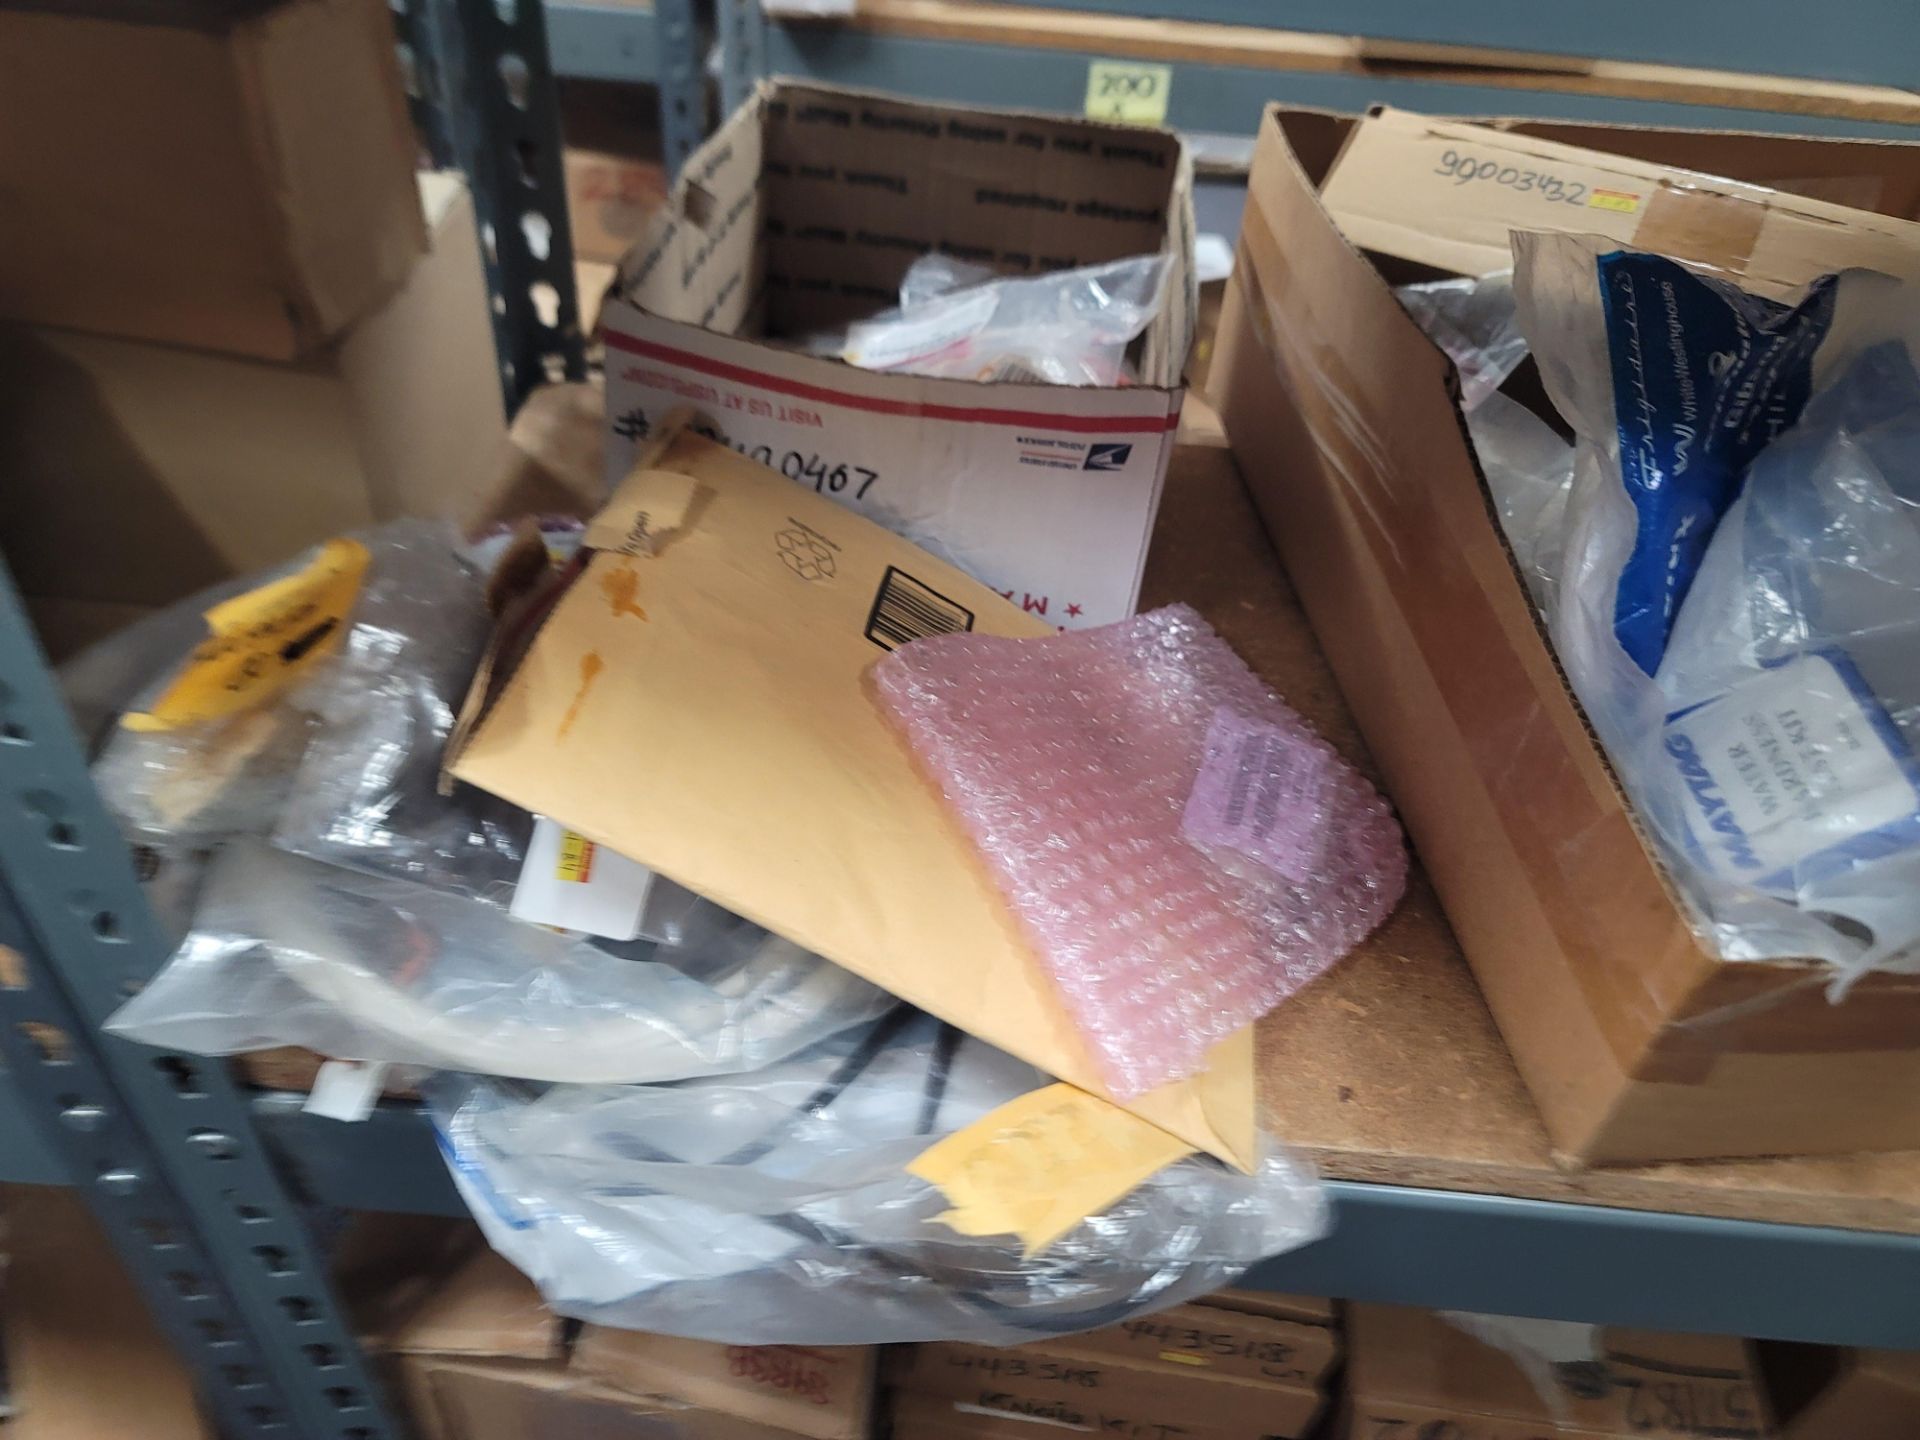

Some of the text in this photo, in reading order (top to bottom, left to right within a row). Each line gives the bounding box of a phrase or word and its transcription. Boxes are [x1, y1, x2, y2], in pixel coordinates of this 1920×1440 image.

[747, 397, 774, 417] US
[778, 407, 824, 428] VISIT
[1663, 733, 1764, 870] MAYTAG
